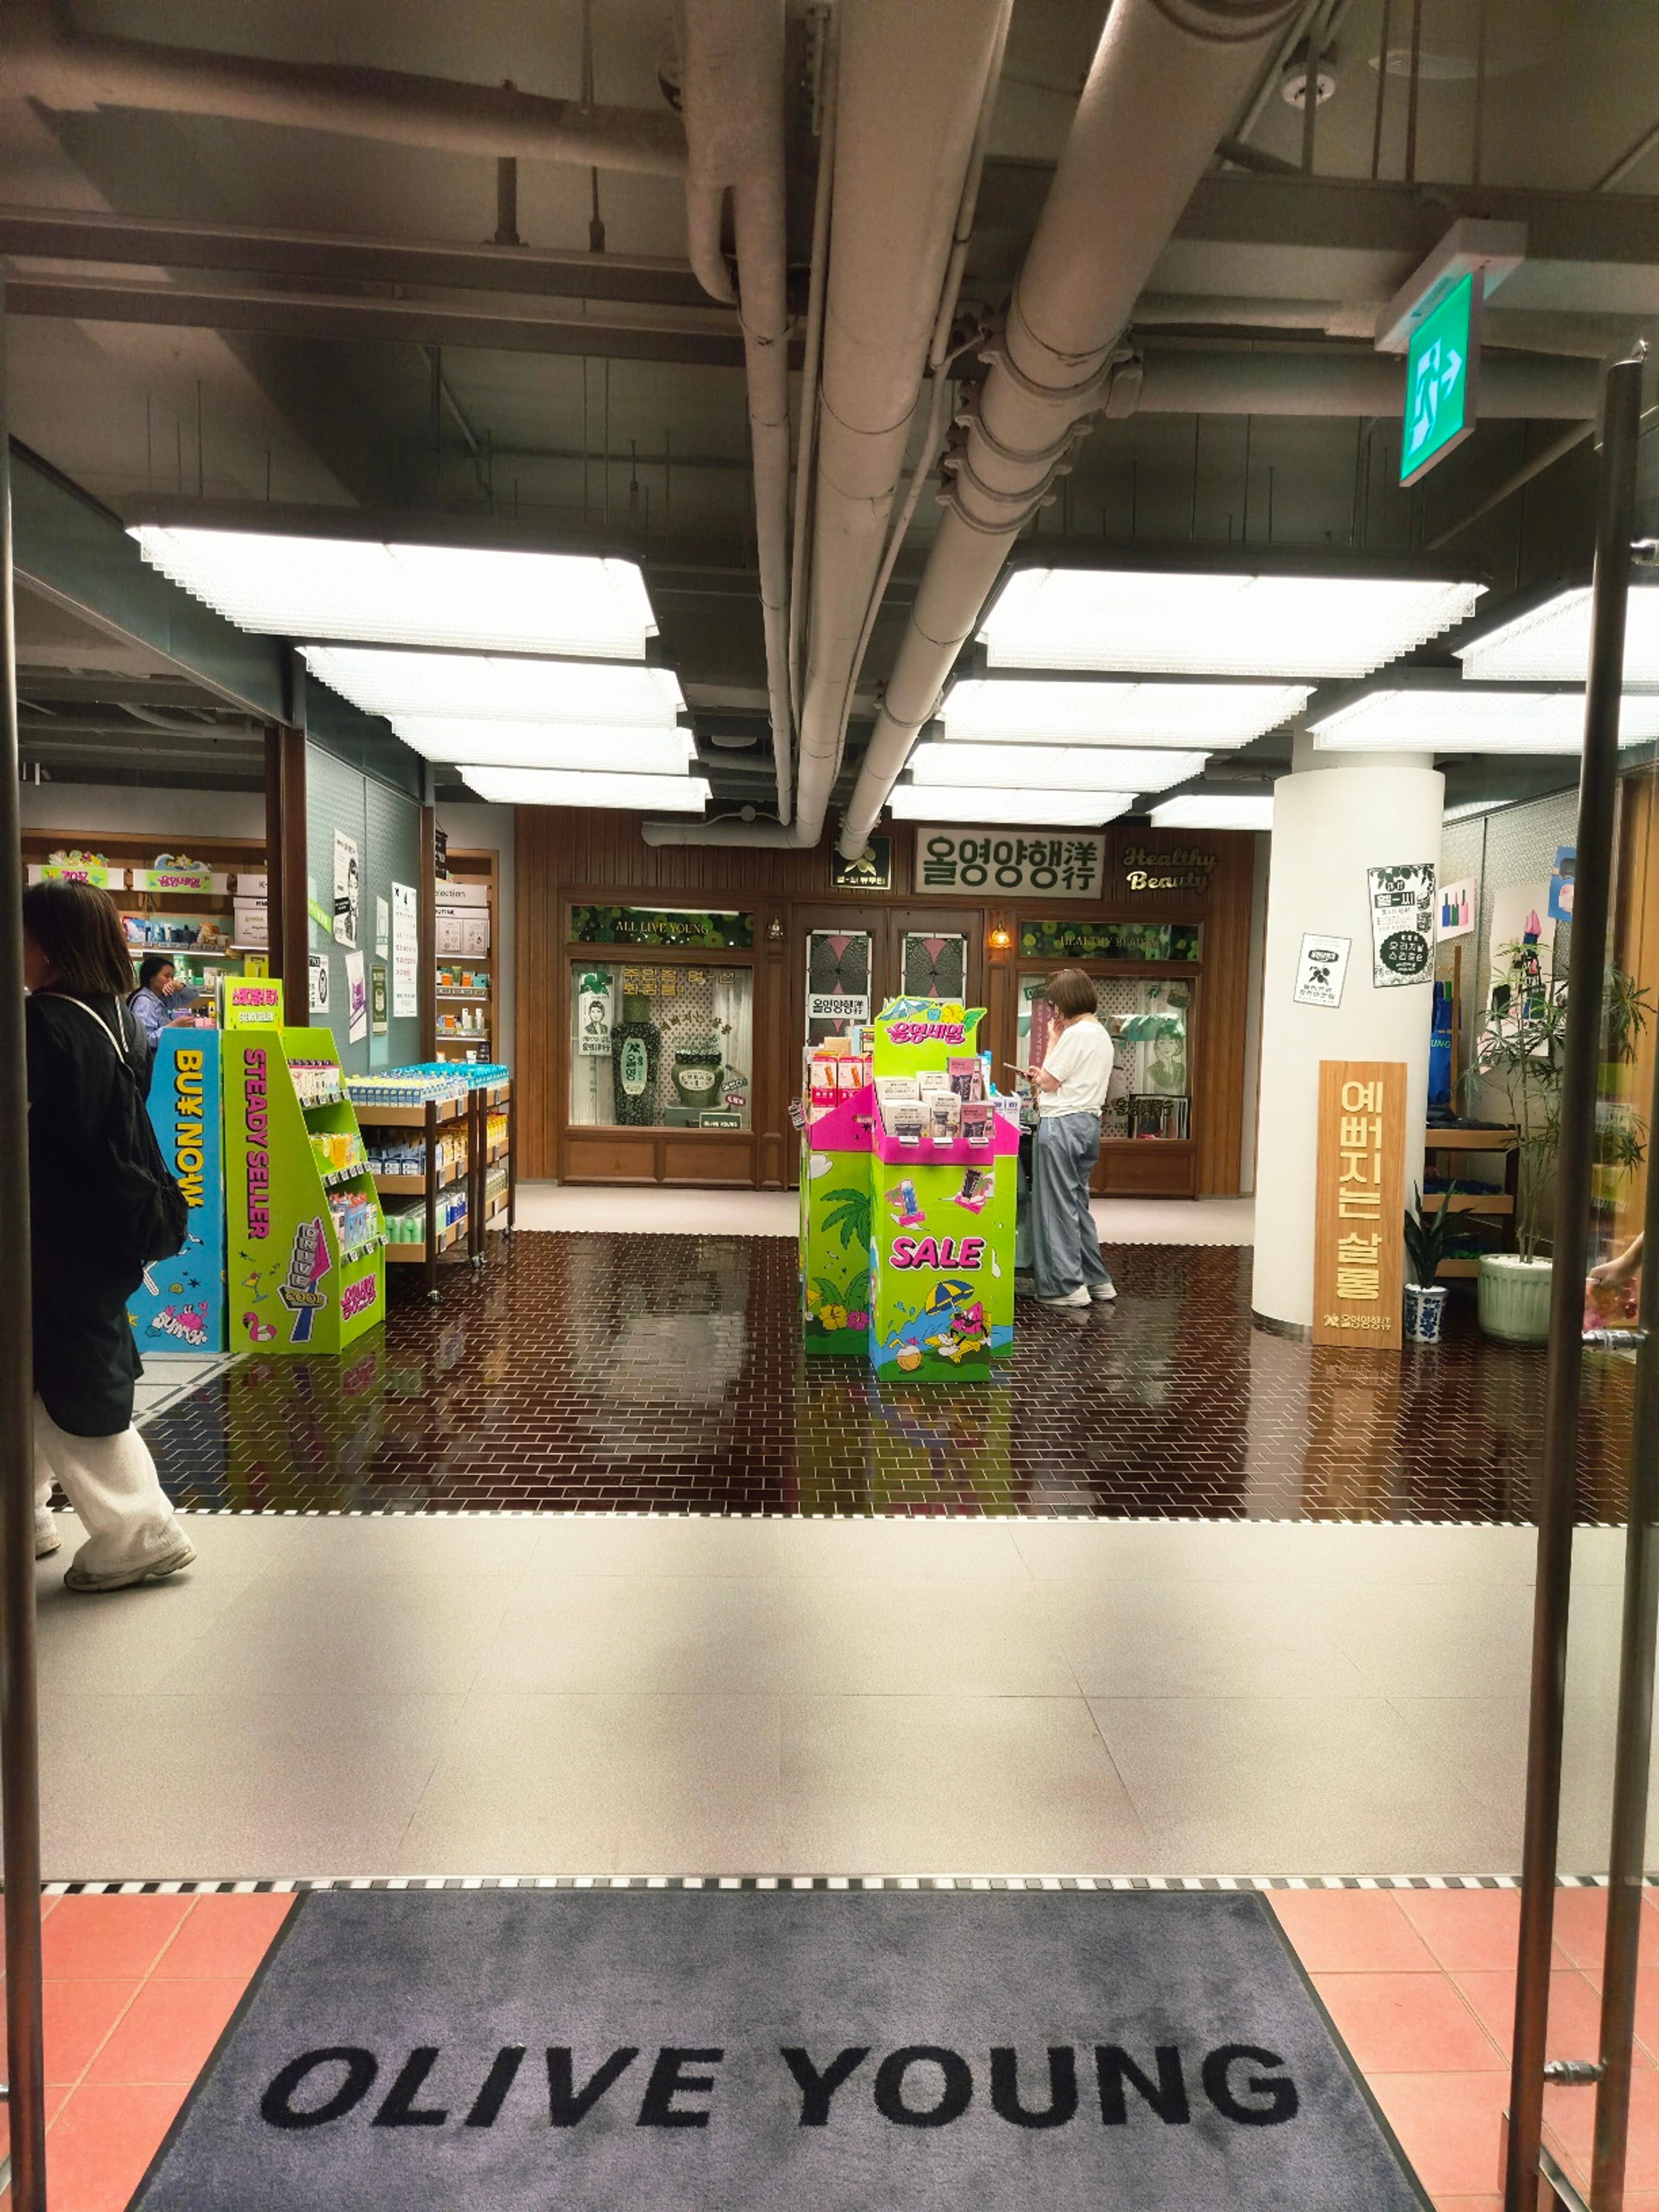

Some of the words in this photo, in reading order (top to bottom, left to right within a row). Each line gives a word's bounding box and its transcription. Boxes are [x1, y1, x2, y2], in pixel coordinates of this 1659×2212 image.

[1124, 847, 1219, 873] Healthy
[1126, 871, 1208, 894] Beauty
[617, 921, 638, 931] ALL
[641, 922, 667, 933] LIVE
[670, 923, 709, 934] YOUNG
[886, 1022, 966, 1045] 올영세일
[243, 1048, 268, 1149] STEADY
[176, 1123, 204, 1208] NOW
[246, 1151, 270, 1240] SELLER
[295, 1227, 315, 1285] DRIVE
[889, 1237, 985, 1271] SALE
[1336, 1231, 1383, 1300] 살롱
[285, 1291, 325, 1305] COOL
[260, 2045, 725, 2129] OLIVE
[779, 2043, 1300, 2129] YOUNG
